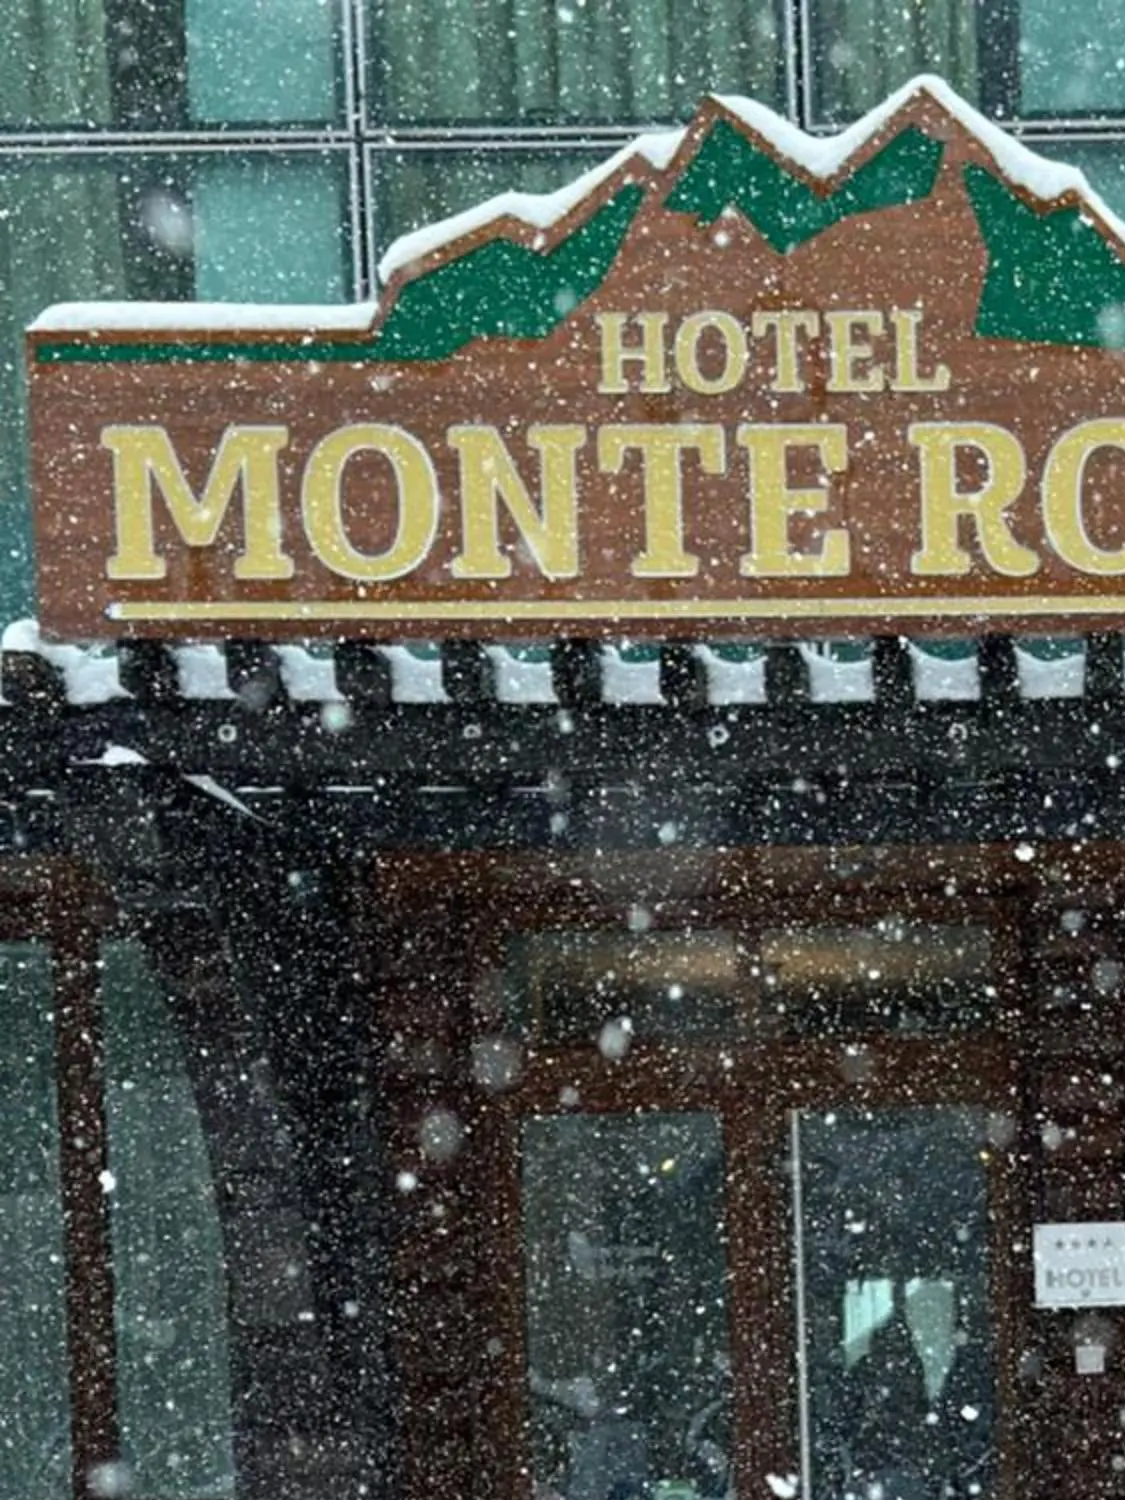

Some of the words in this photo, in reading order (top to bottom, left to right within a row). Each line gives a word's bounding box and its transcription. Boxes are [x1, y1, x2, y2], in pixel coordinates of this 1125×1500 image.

[598, 310, 951, 396] HOTEL
[100, 421, 850, 580] MONTE
[1046, 1269, 1123, 1288] HOTEL
